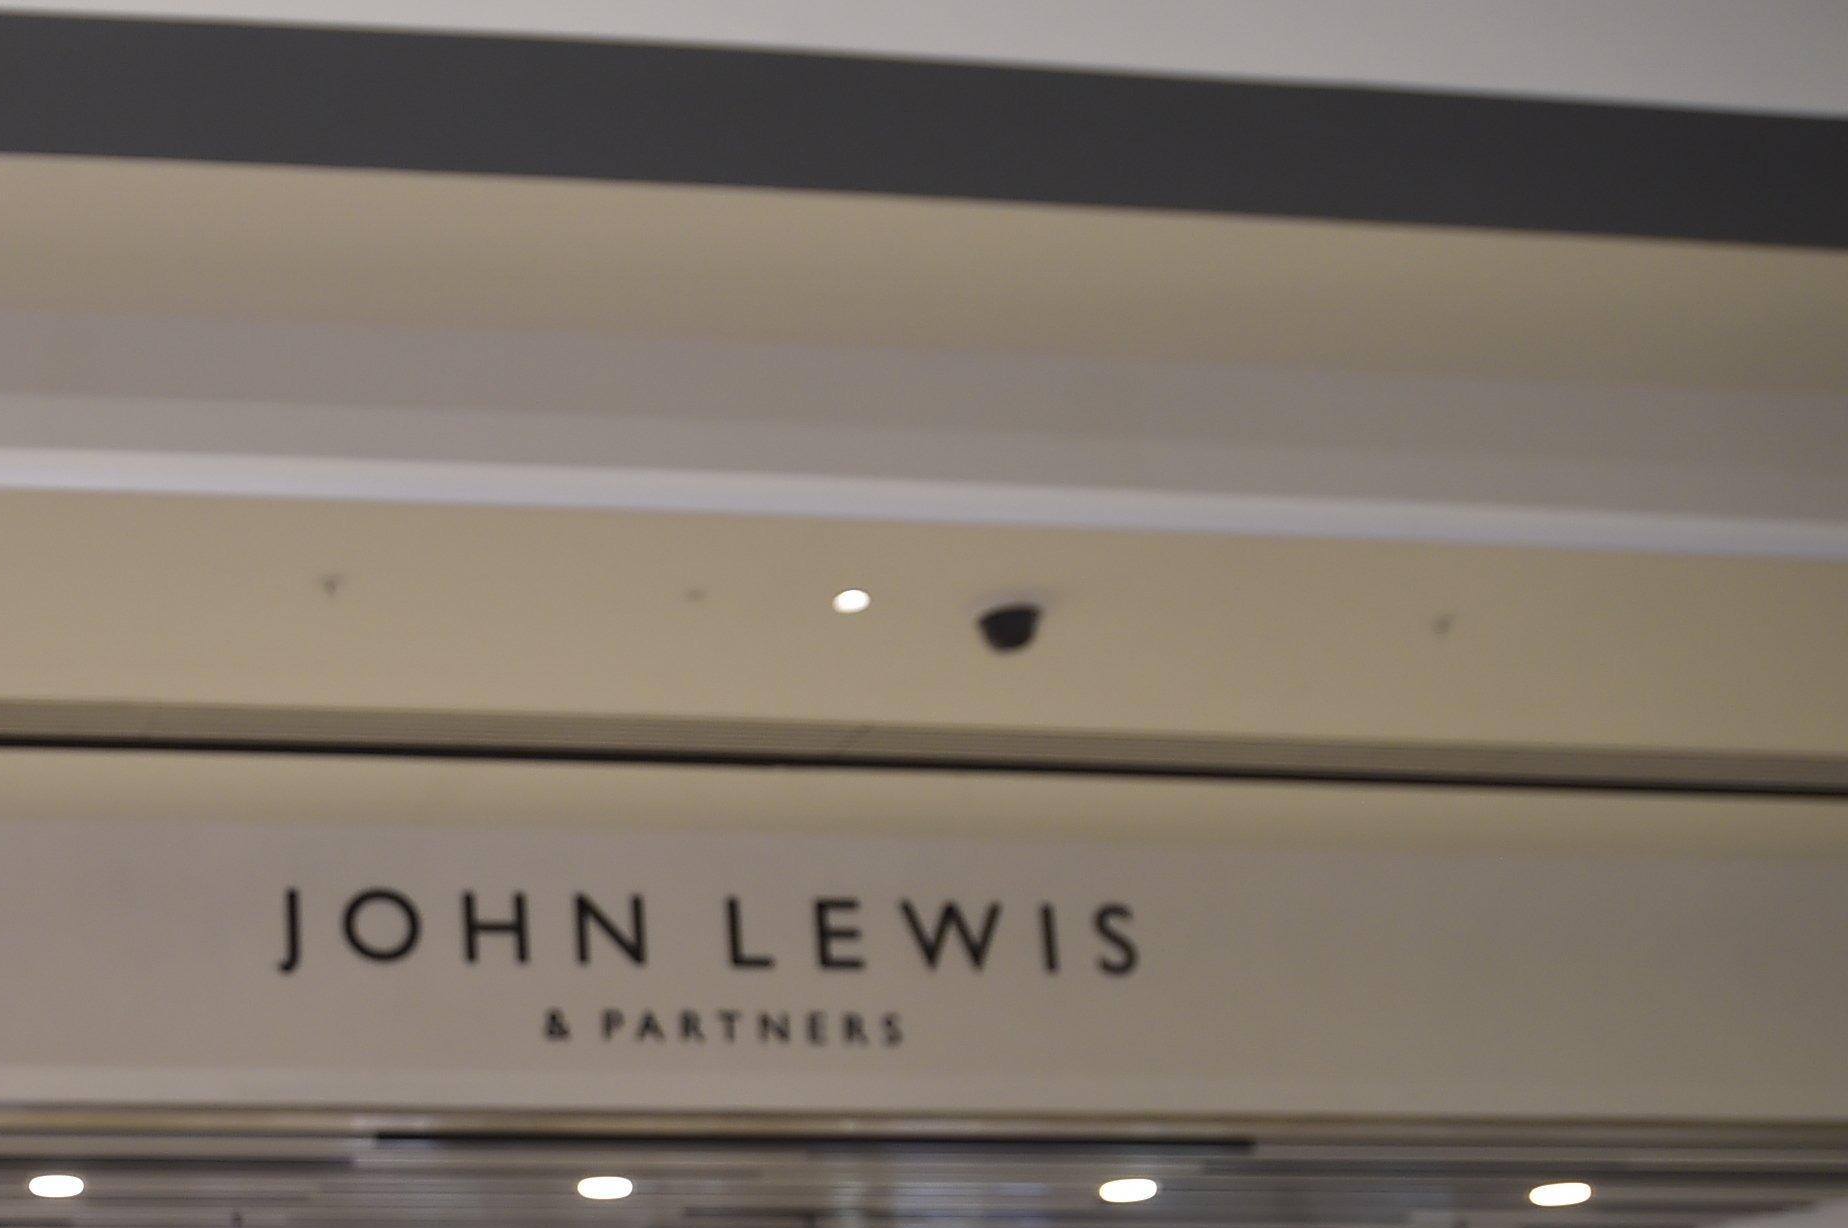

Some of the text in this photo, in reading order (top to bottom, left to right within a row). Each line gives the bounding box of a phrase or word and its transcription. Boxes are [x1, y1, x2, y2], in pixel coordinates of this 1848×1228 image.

[277, 886, 1140, 978] JOHN LEWIS
[543, 1008, 903, 1047] & PARTNERS
